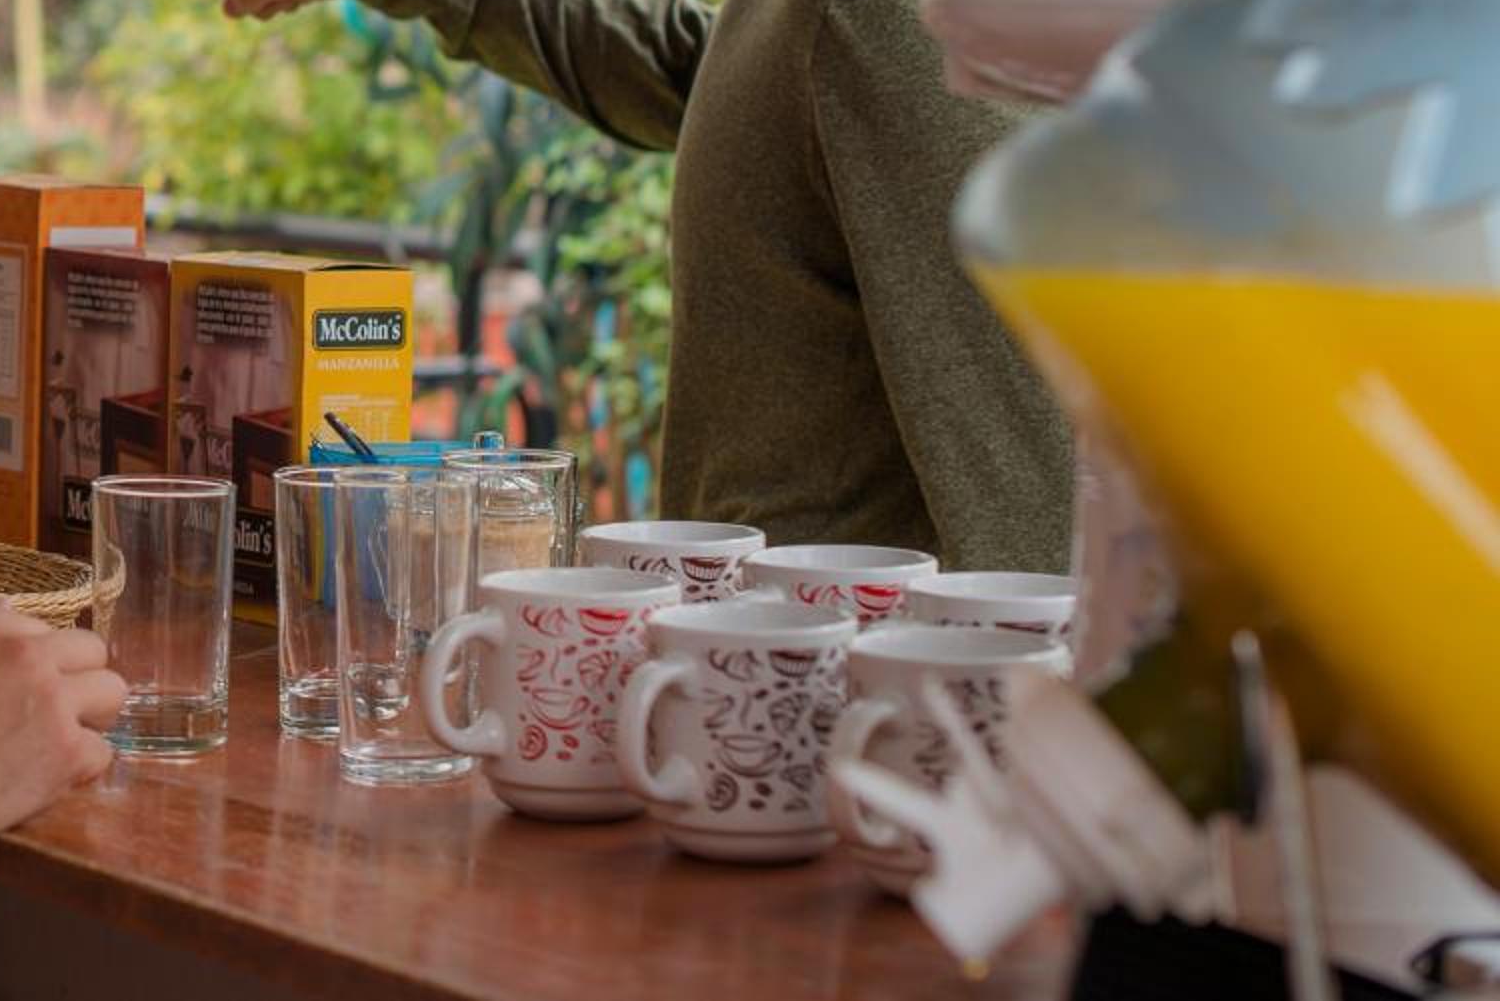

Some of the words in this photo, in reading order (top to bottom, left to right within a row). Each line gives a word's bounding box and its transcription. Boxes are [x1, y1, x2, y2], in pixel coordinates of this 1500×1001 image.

[320, 316, 401, 341] McColin's
[317, 357, 399, 370] MANZANILLA
[234, 521, 272, 554] olin's
